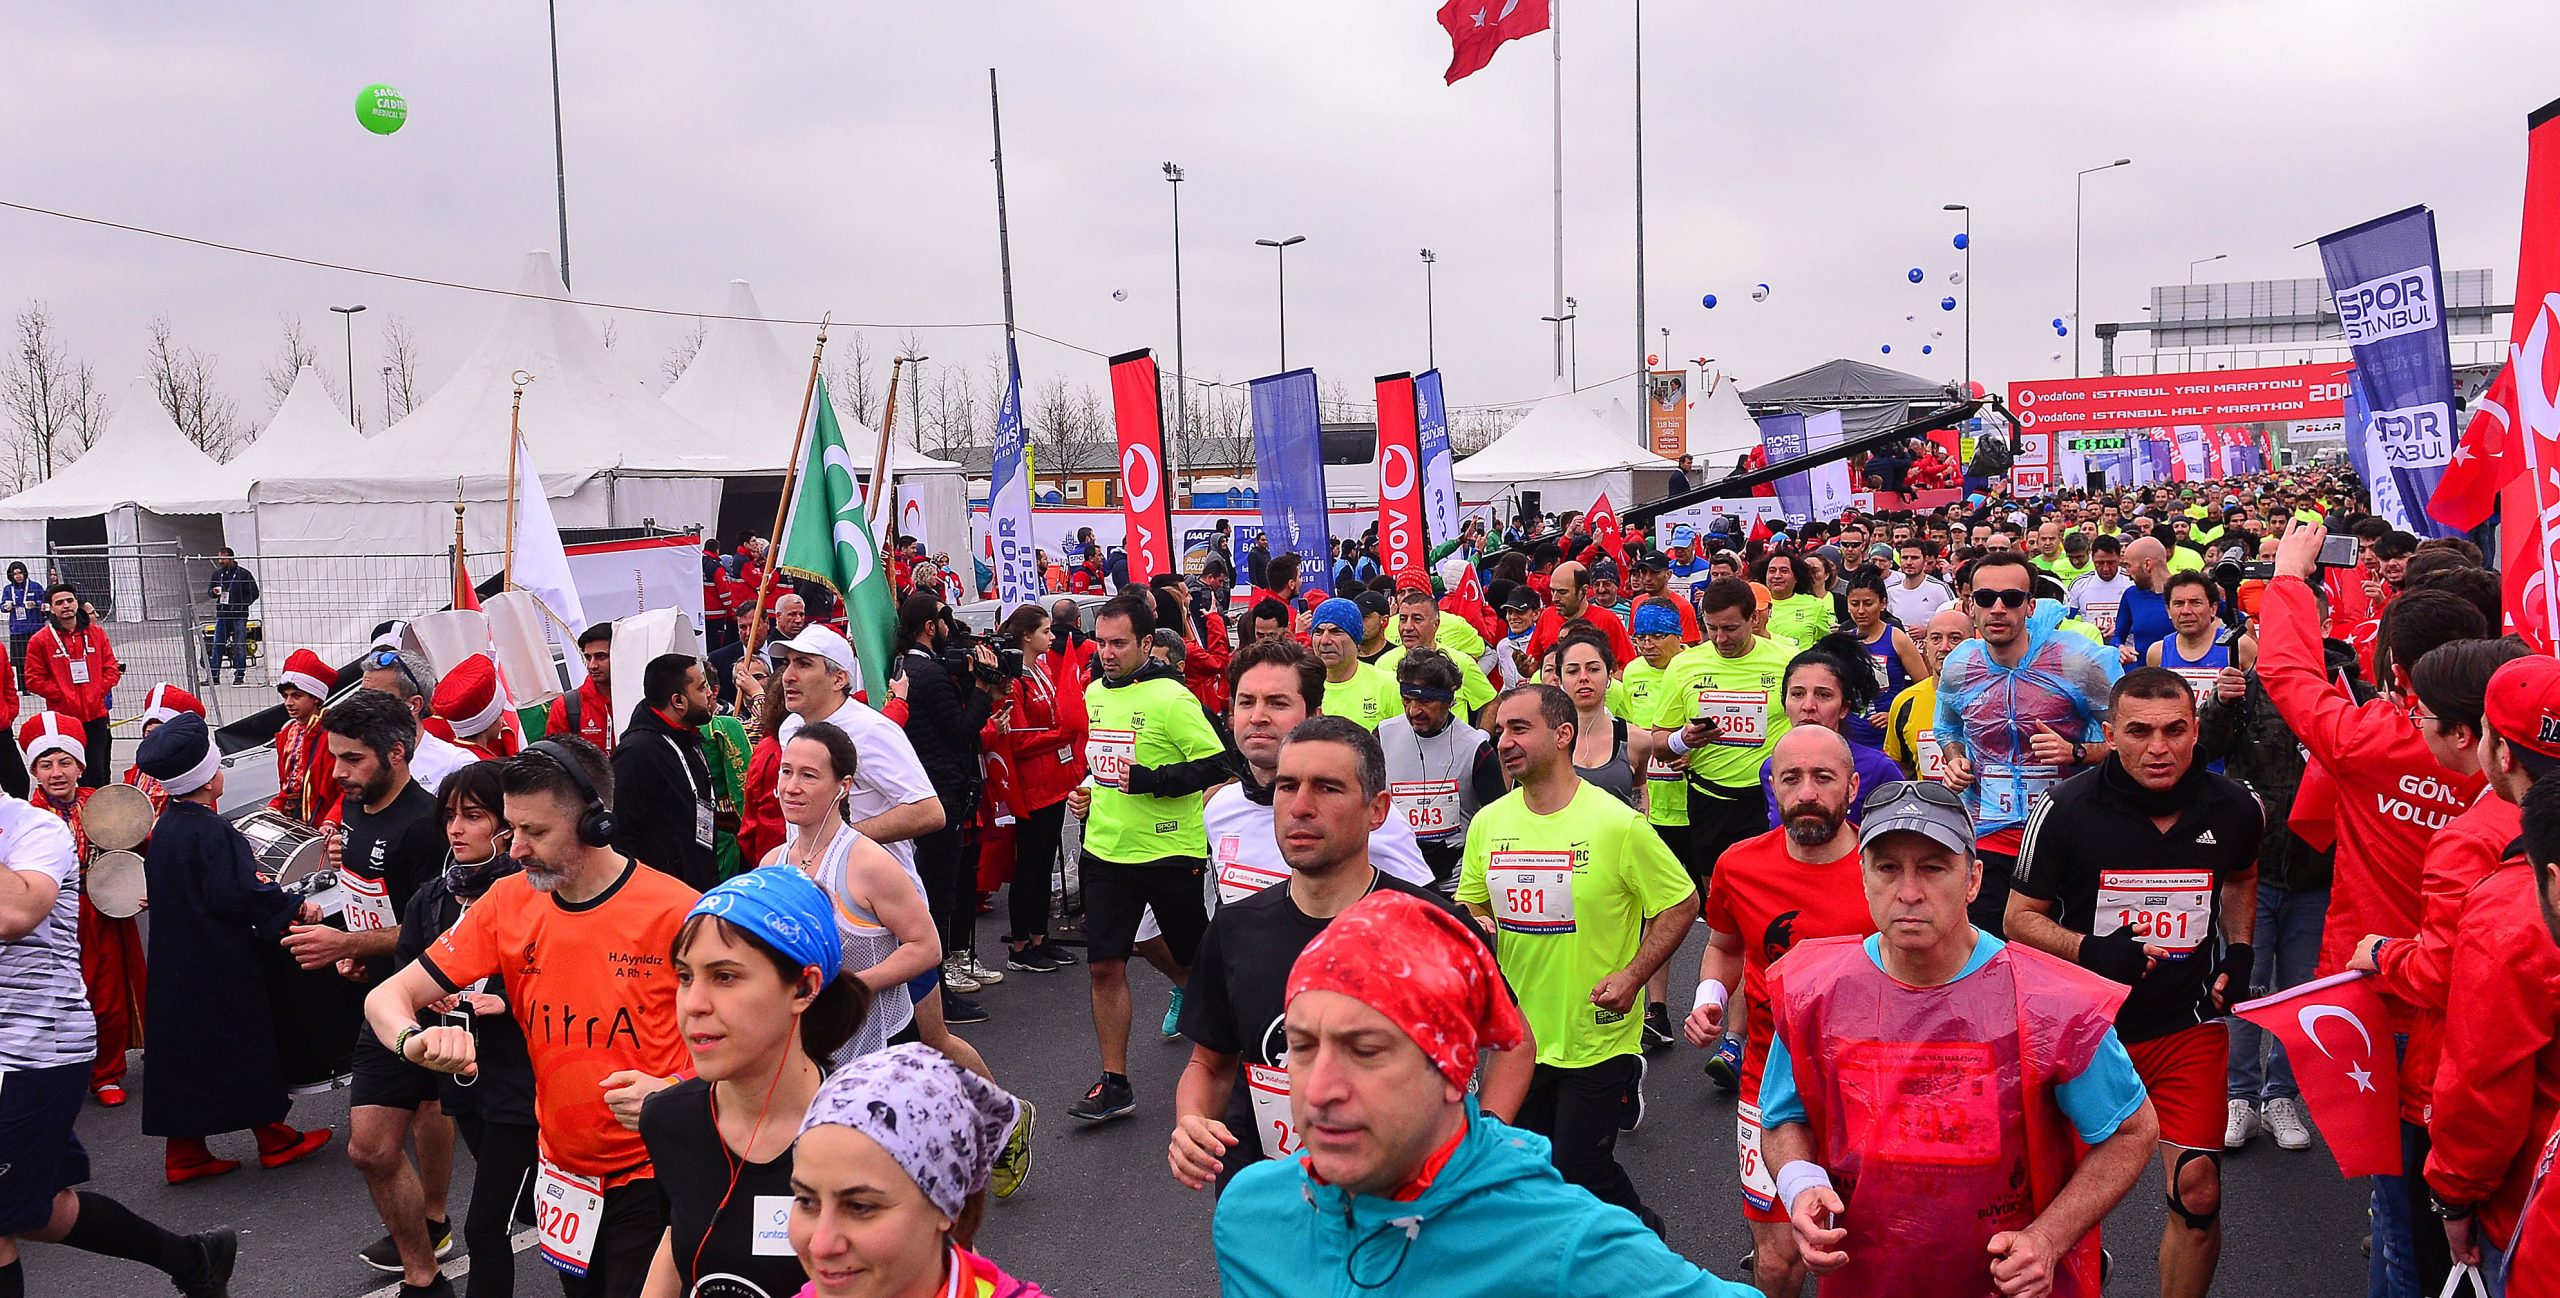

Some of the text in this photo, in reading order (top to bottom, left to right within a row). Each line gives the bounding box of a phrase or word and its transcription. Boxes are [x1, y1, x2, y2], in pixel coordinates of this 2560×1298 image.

[2339, 275, 2428, 321] SPOR
[2037, 391, 2086, 402] vodafone
[2174, 385, 2210, 395] YARI
[2213, 379, 2303, 392] MARATONU
[2037, 412, 2086, 423] vodafone
[2171, 406, 2213, 416] HALF
[2216, 401, 2304, 414] MARATHON
[2295, 422, 2342, 433] POLAR
[1186, 532, 1211, 541] IAAF
[999, 517, 1017, 603] SPOR
[1363, 702, 1377, 710] NRC
[1131, 717, 1146, 726] NRC
[2399, 775, 2464, 807] GÖN
[1408, 807, 1443, 827] 643
[2377, 793, 2457, 830] VOLU
[1506, 889, 1544, 913] 581
[345, 903, 383, 930] 1518
[2118, 909, 2188, 939] 1861
[615, 968, 624, 977] A
[627, 968, 640, 978] Rh
[537, 1193, 580, 1244] 820
